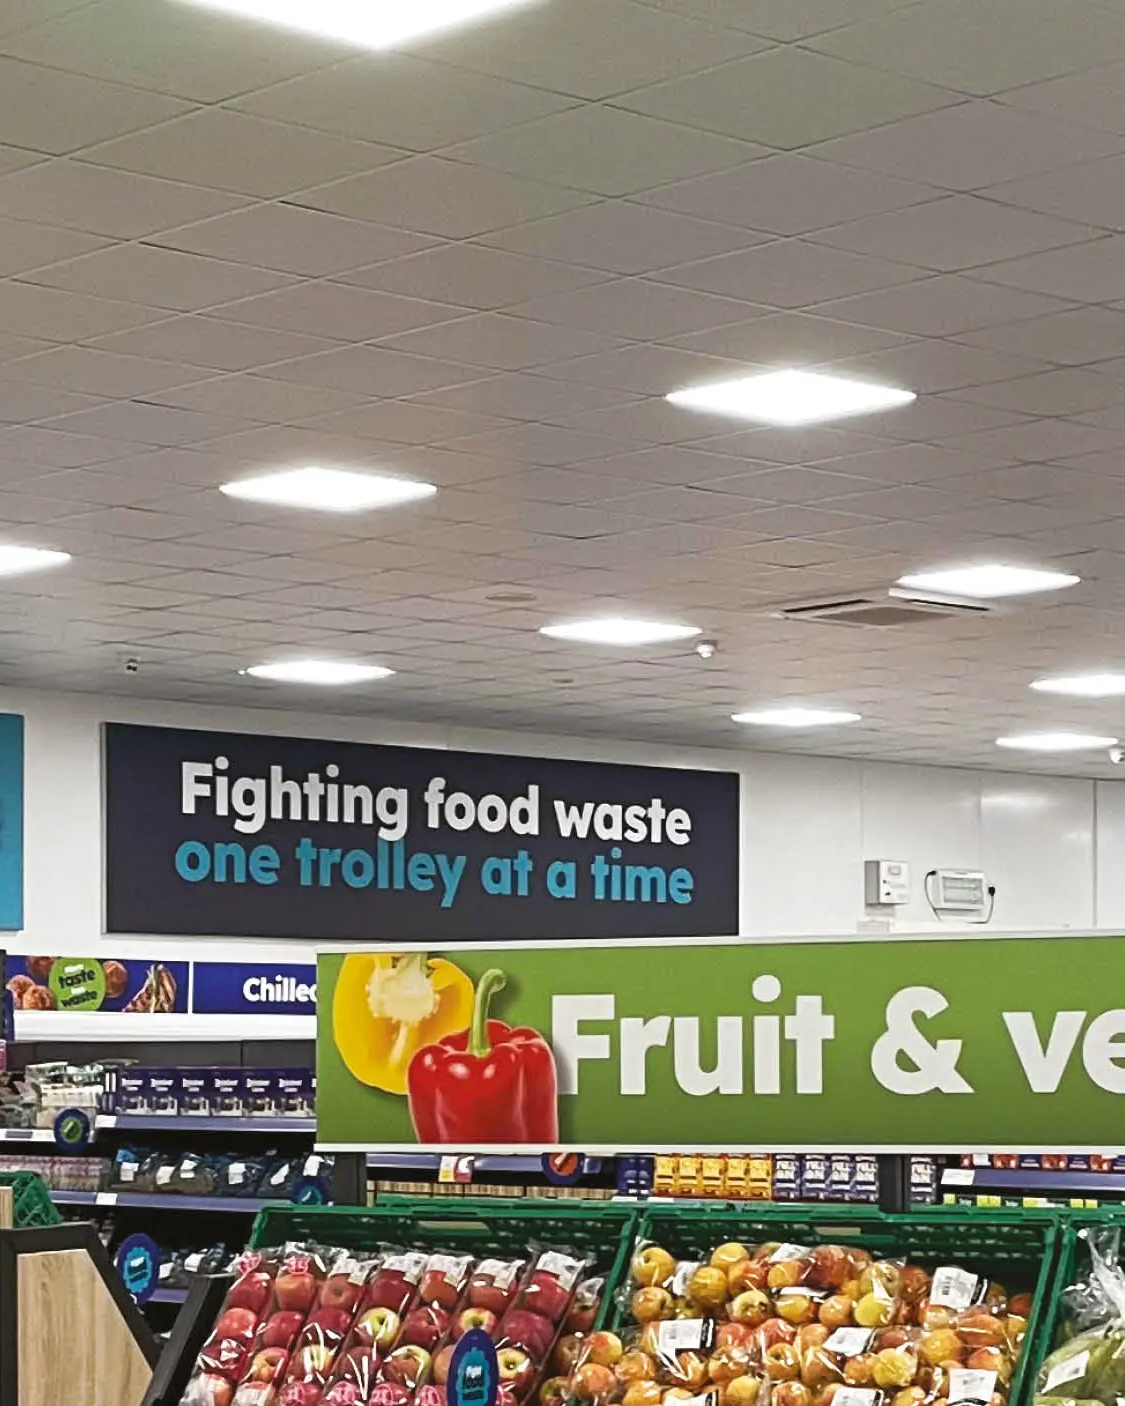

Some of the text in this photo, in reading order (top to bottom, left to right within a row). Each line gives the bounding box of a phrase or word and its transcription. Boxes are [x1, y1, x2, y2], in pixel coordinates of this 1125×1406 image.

[182, 756, 692, 845] Fighting food waste
[175, 837, 693, 907] one trolley at a time
[551, 973, 836, 1096] Fruit
[870, 986, 975, 1095] &
